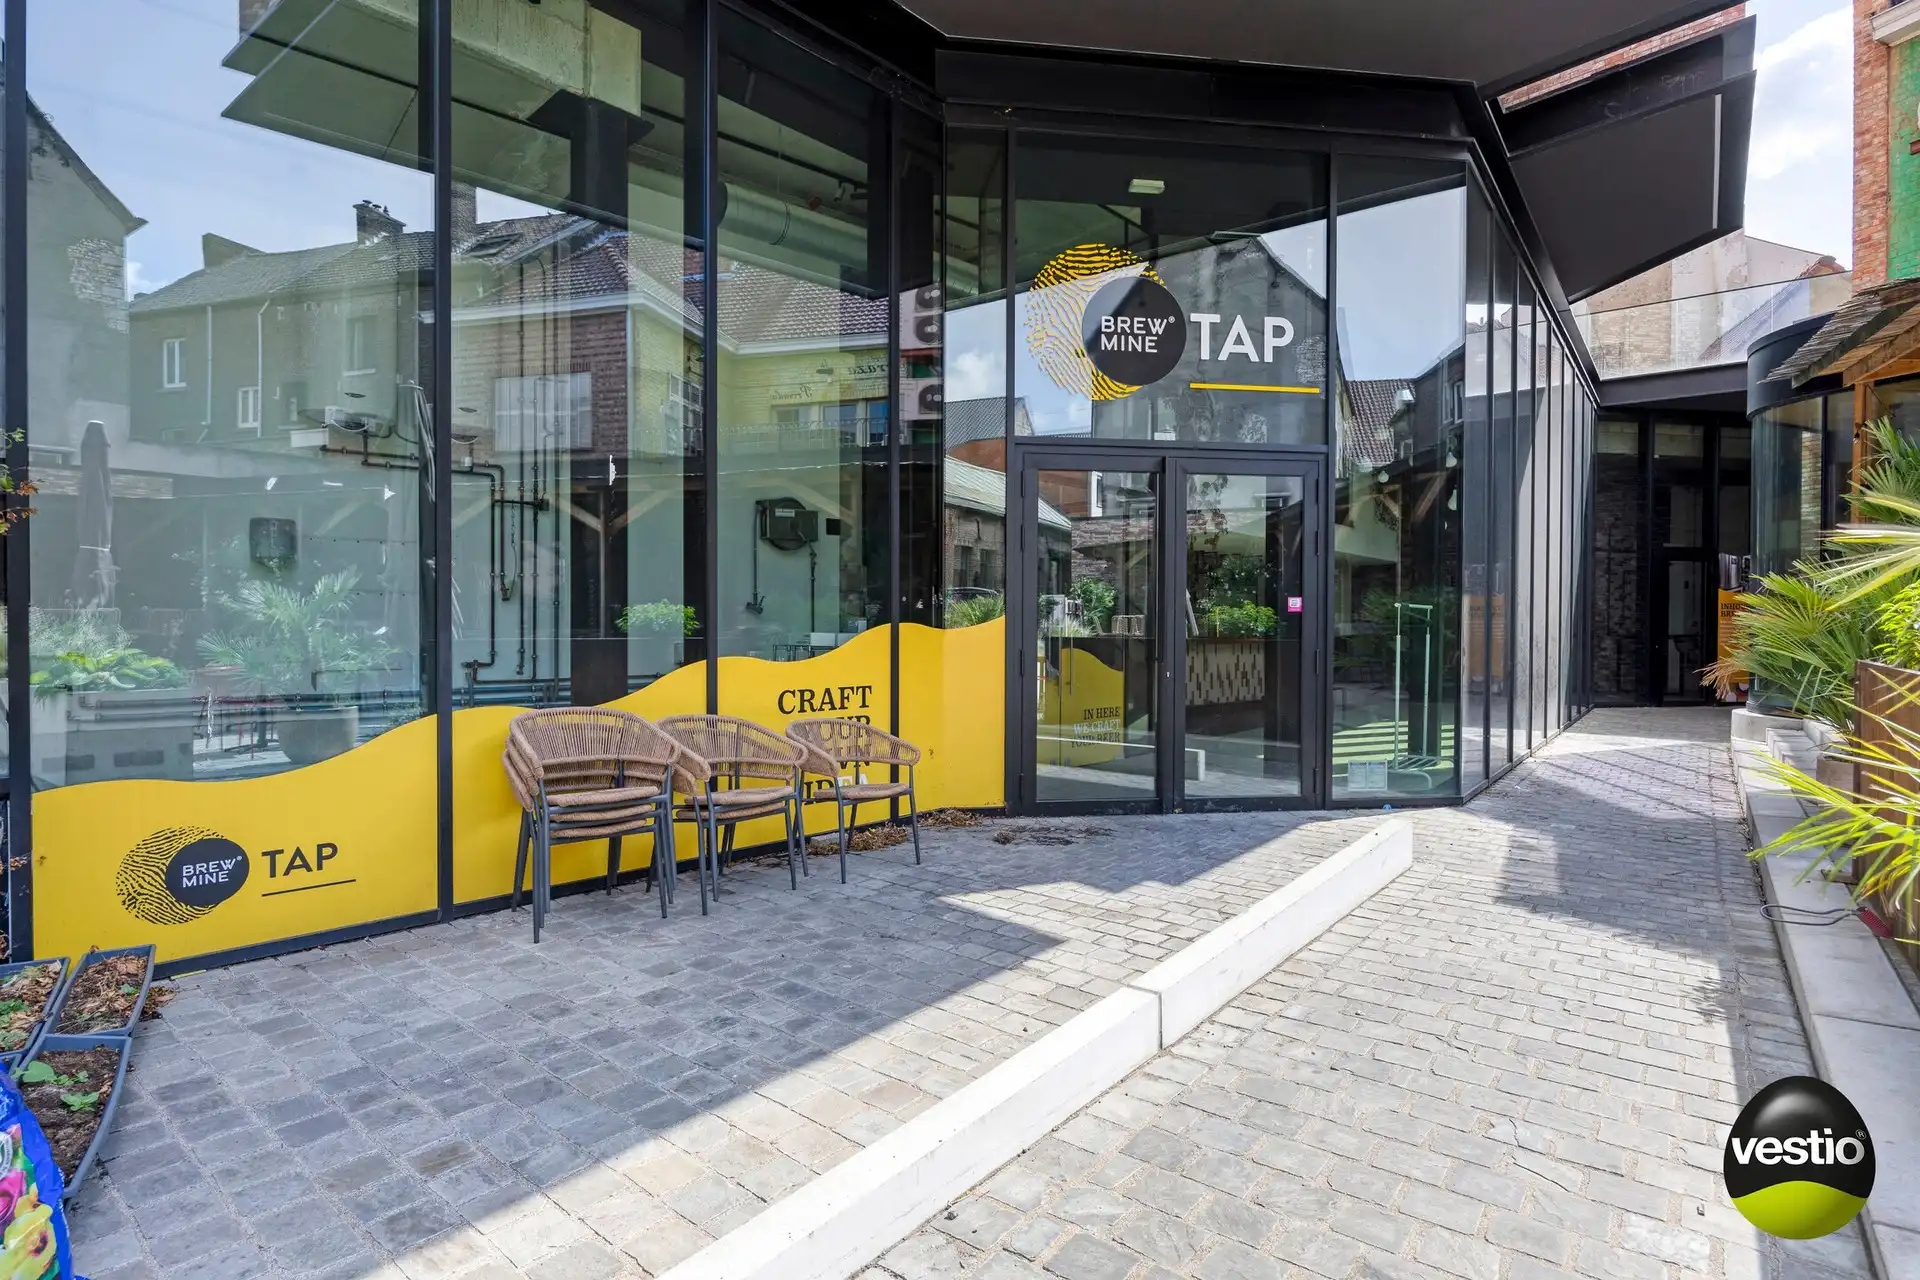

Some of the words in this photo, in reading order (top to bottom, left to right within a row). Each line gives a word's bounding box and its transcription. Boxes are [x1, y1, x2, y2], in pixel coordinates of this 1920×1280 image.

[1101, 334, 1158, 353] MINE
[1189, 312, 1295, 363] TAP
[777, 685, 873, 715] CRAFT
[1084, 709, 1094, 720] IN
[1096, 707, 1120, 719] HERE
[1091, 719, 1120, 732] CRAFT
[1097, 732, 1120, 745] BEER
[261, 842, 339, 879] TAP
[182, 870, 229, 888] MINE
